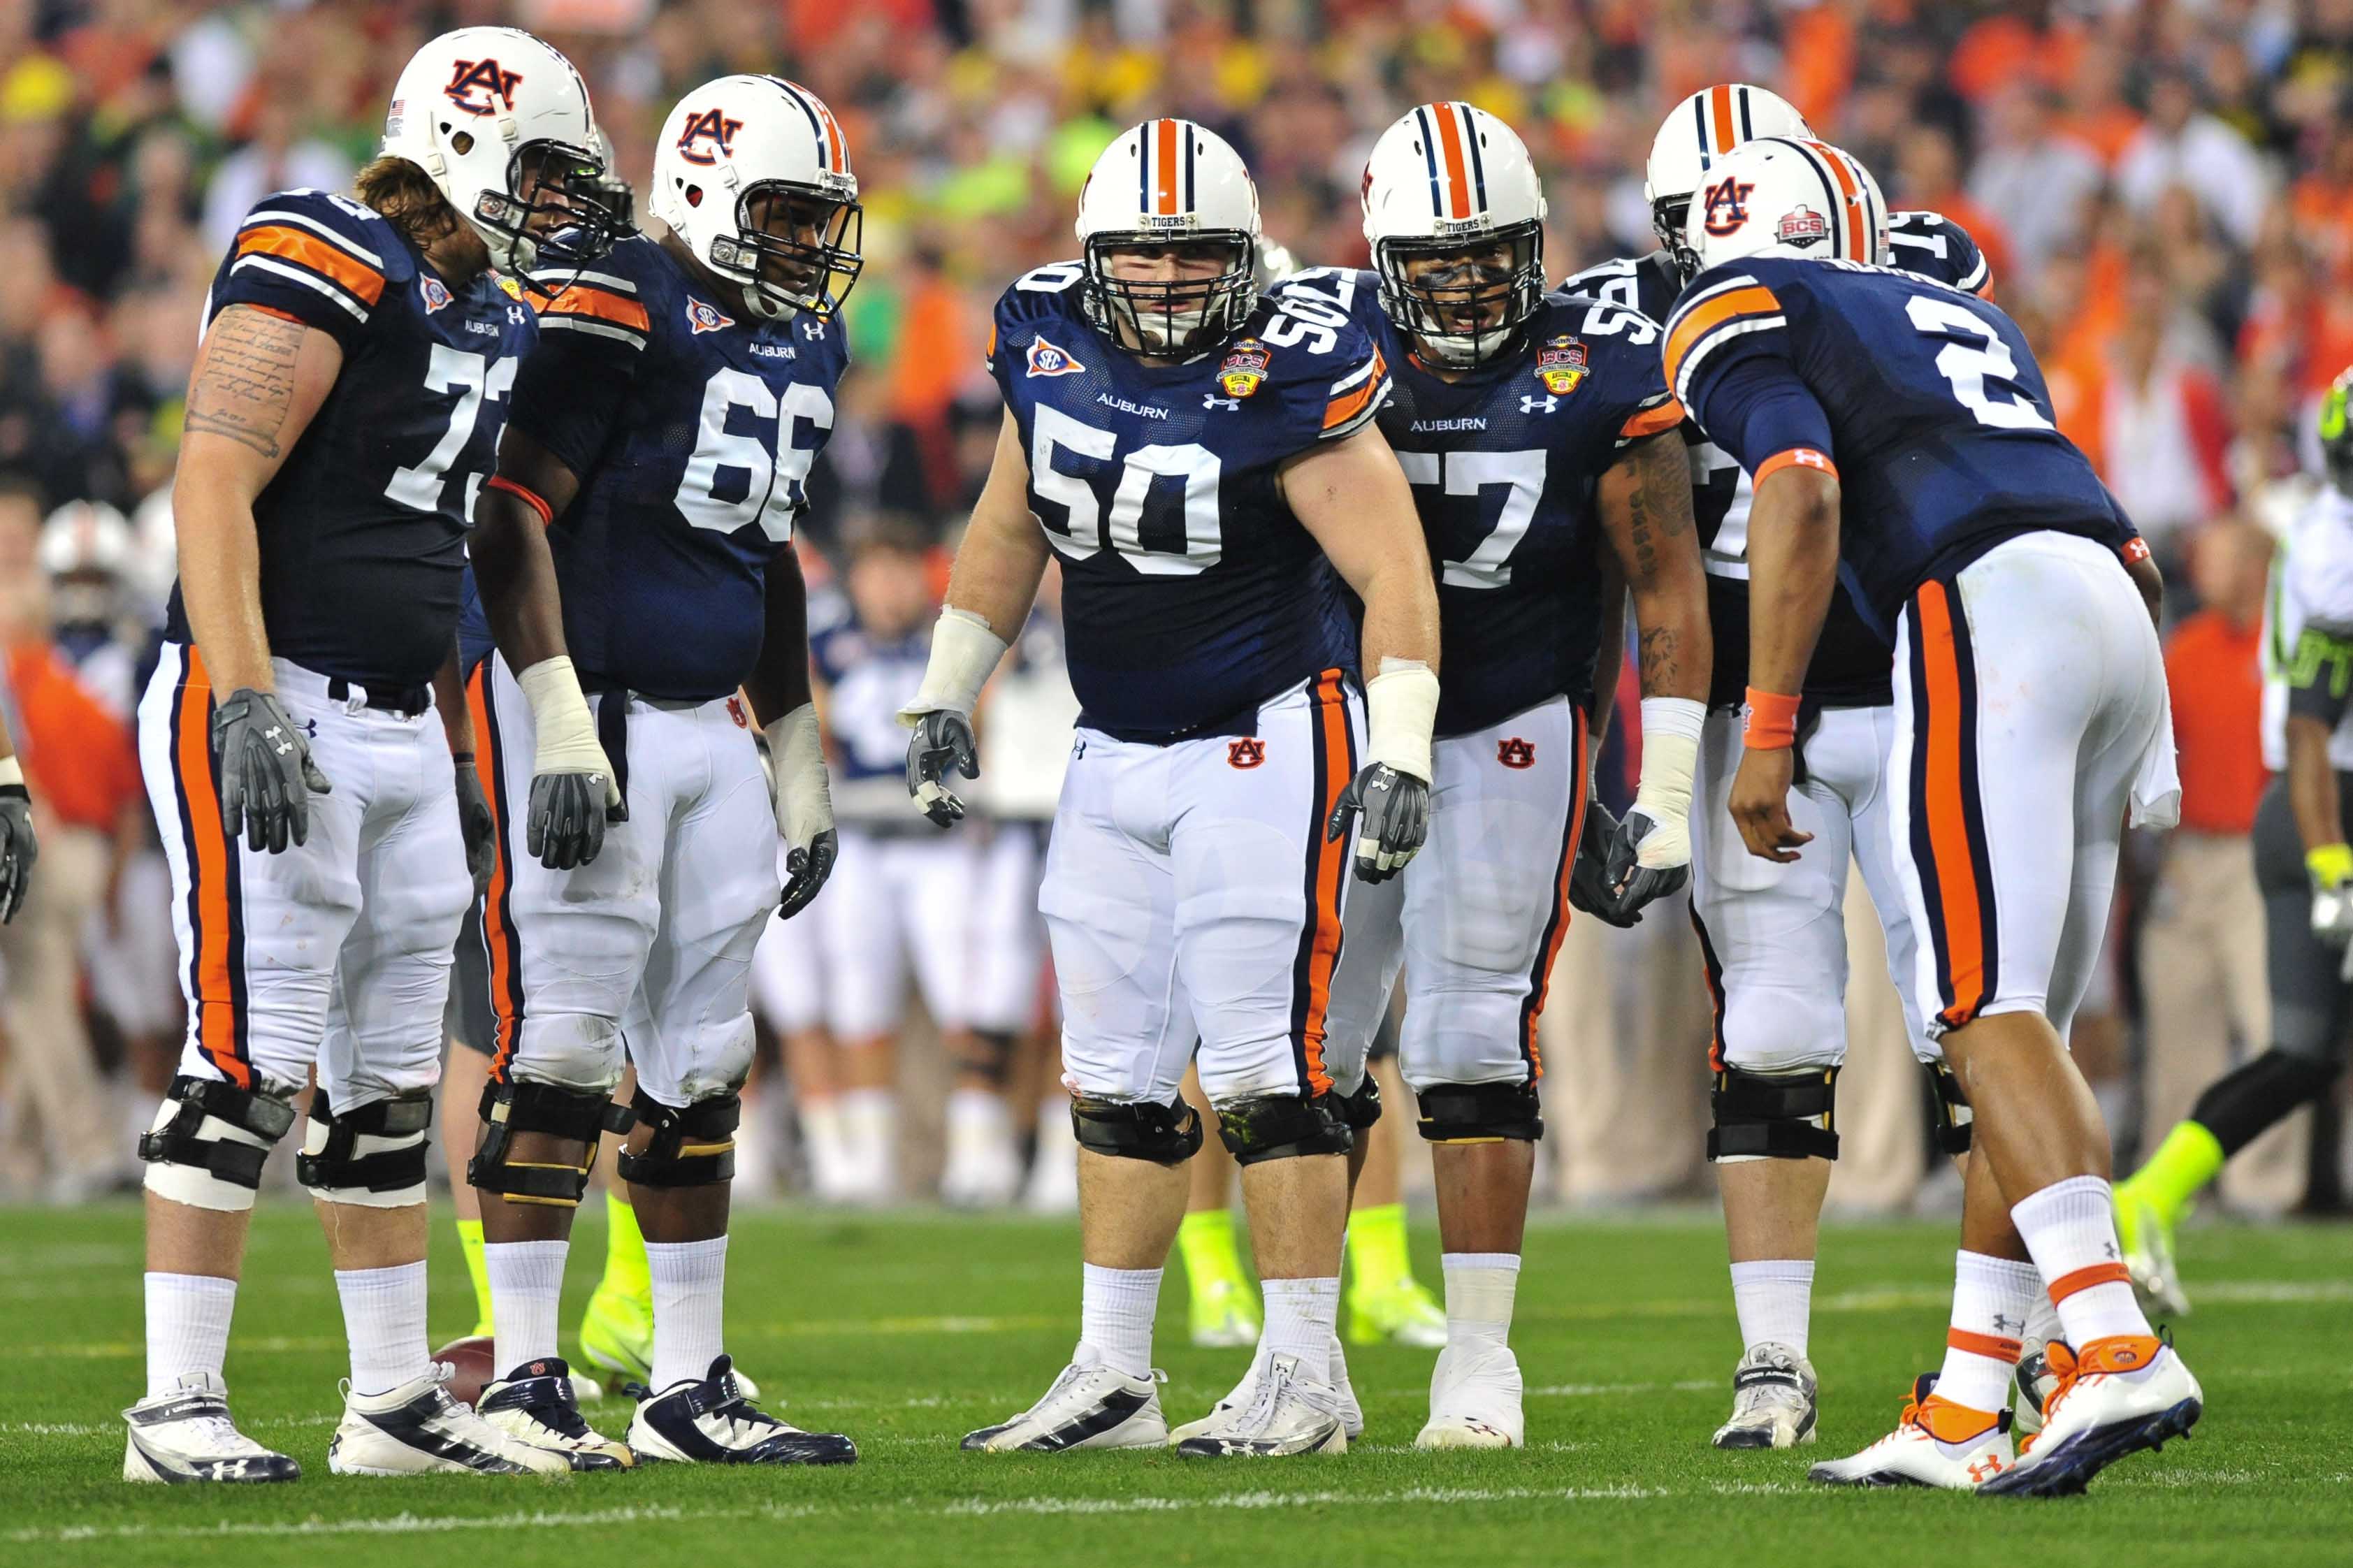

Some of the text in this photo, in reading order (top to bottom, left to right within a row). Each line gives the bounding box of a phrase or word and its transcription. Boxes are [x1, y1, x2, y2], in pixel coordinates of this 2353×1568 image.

[1152, 217, 1185, 227] TIGERS
[1445, 219, 1479, 232] TIGERS
[1783, 220, 1822, 235] BCS
[465, 319, 500, 337] AUBURN
[1260, 298, 1349, 354] 50
[748, 342, 796, 359] AUBURN
[1542, 349, 1583, 365] BCS
[1038, 349, 1062, 371] SEC
[1904, 298, 2057, 431] 2
[1096, 393, 1170, 420] AUBURN
[1410, 418, 1487, 433] AUBURN
[673, 366, 834, 542] 66
[1031, 402, 1222, 576] 50
